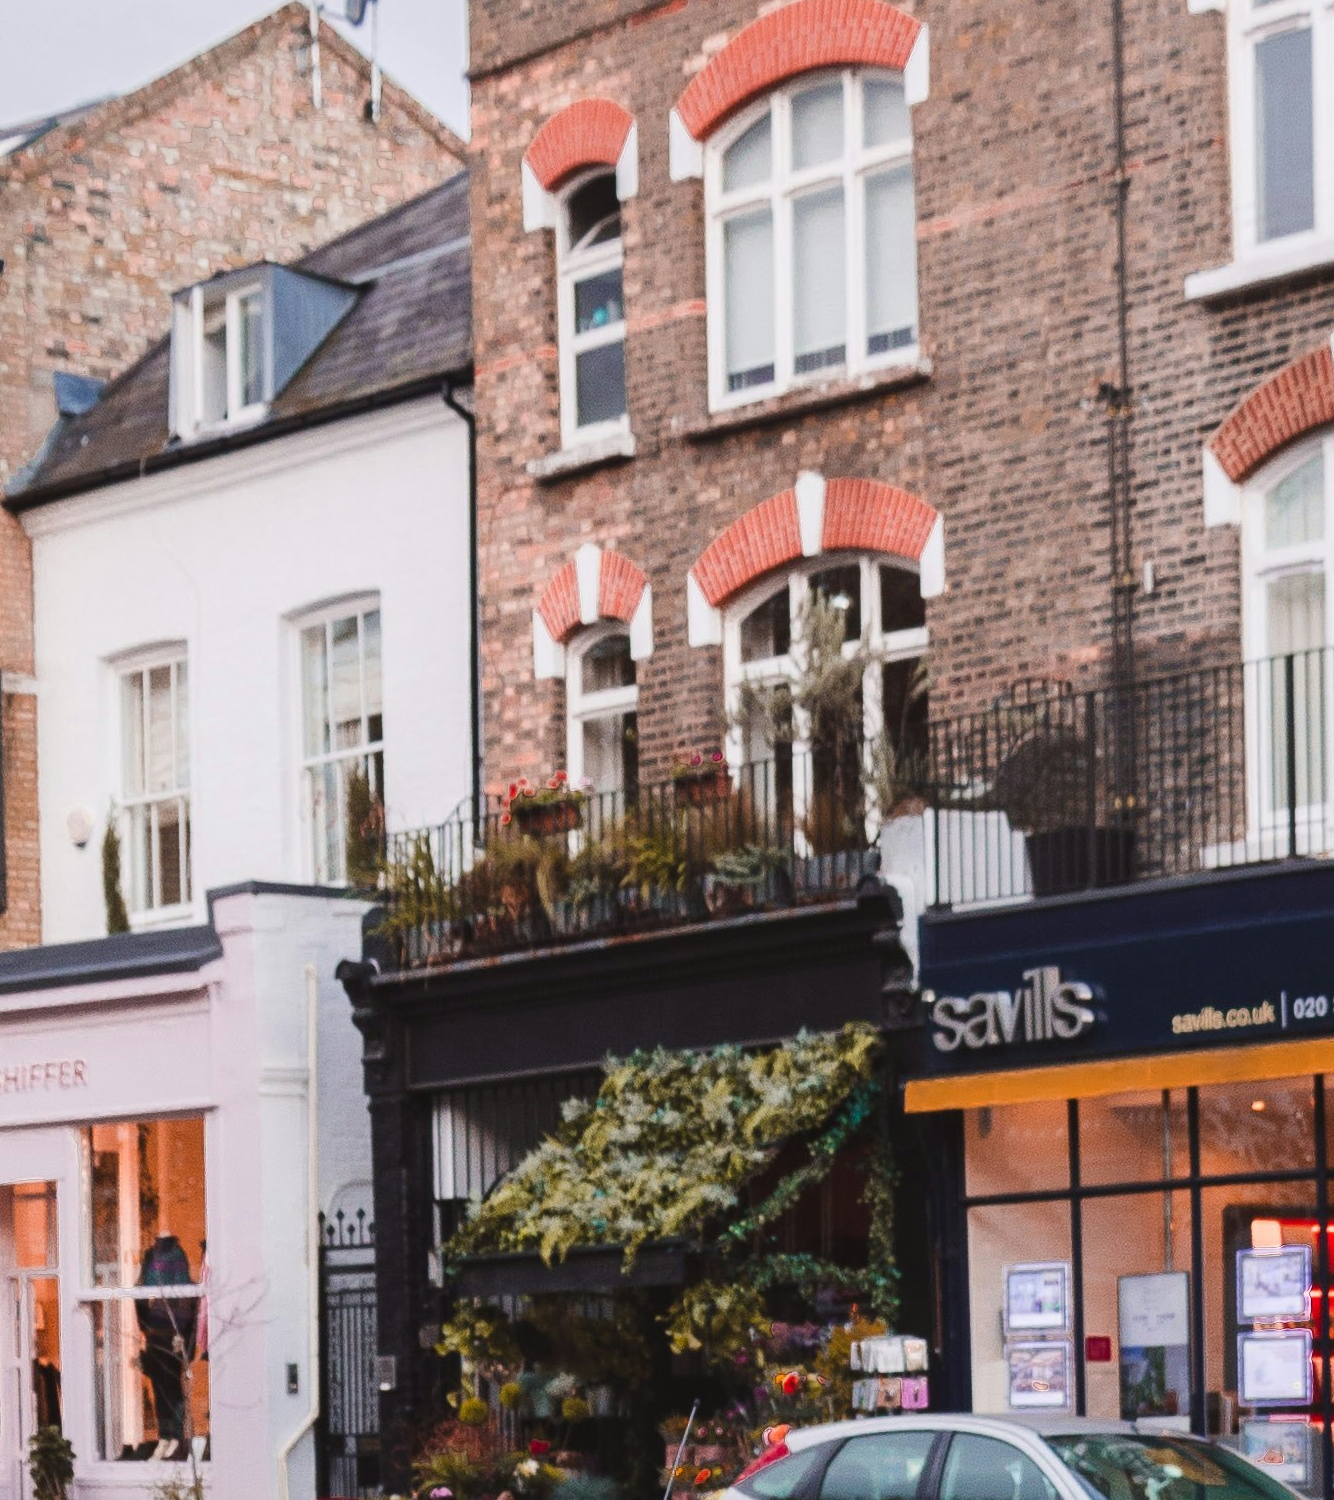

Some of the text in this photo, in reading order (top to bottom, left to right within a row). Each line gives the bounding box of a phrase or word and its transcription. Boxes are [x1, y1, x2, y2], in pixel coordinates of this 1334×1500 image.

[932, 964, 1095, 1051] savills
[1171, 1000, 1276, 1034] savills.co.uk
[1292, 995, 1328, 1020] 020
